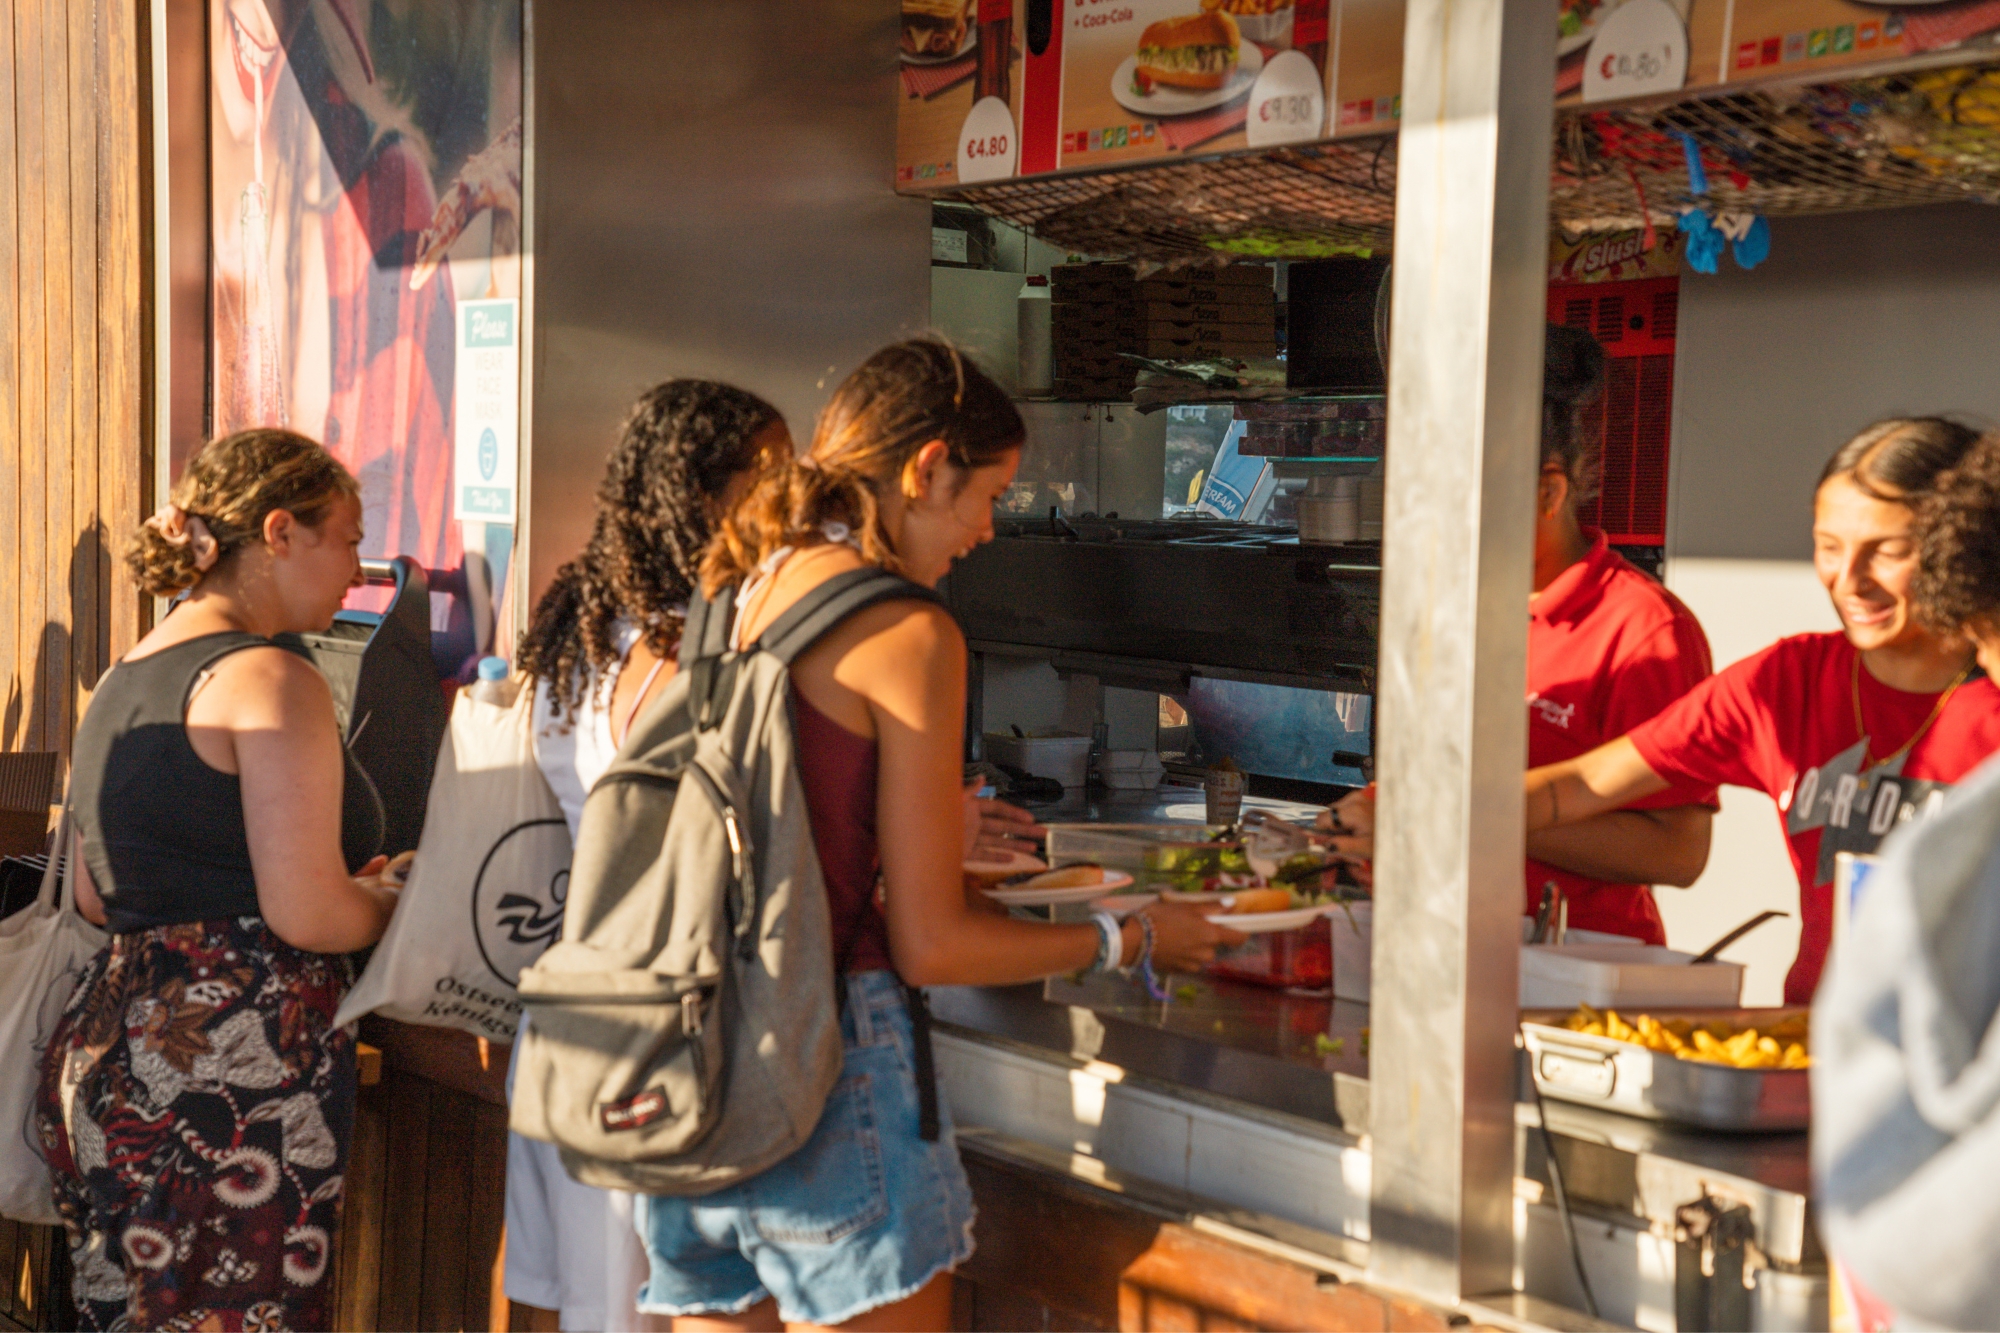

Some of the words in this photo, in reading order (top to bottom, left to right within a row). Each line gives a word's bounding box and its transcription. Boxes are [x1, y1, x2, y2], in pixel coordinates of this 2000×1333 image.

[1082, 7, 1133, 28] Coca-Cola
[967, 134, 1008, 159] €4.80
[472, 310, 507, 342] Please
[475, 352, 503, 370] WEAR
[476, 376, 501, 395] FACE
[424, 1001, 517, 1038] Königs
